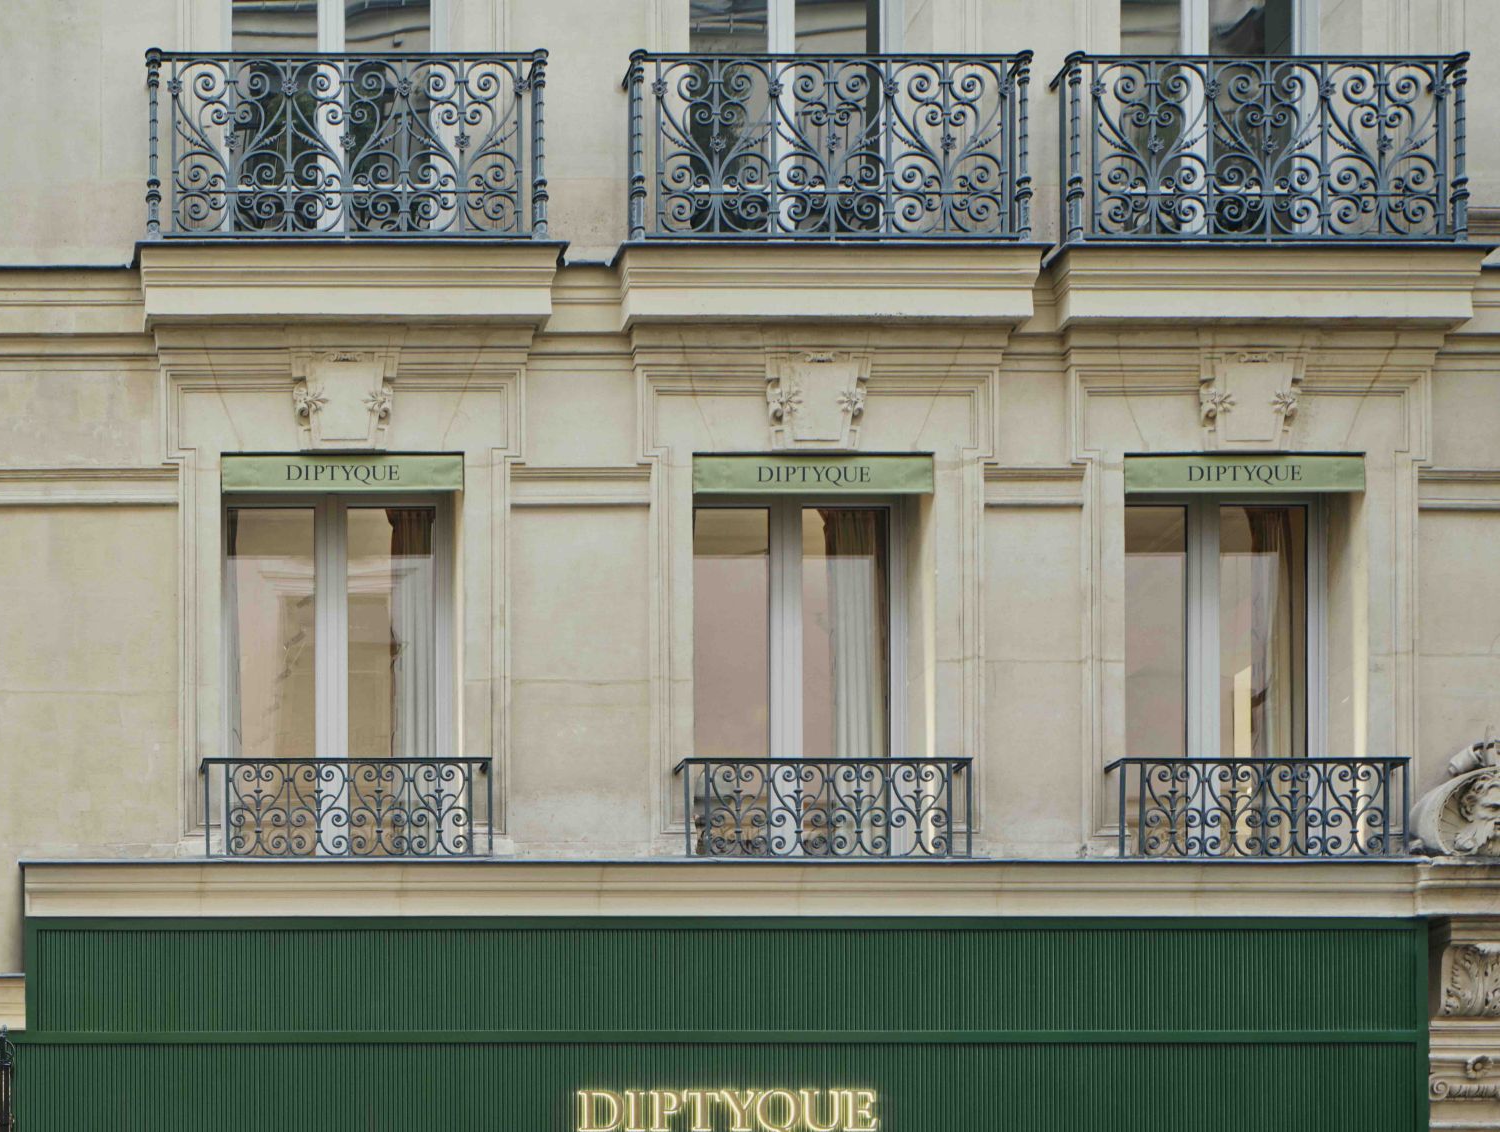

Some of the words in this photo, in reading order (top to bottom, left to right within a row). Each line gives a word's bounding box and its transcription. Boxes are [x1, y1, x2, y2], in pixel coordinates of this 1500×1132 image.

[285, 464, 400, 485] DIPTYQUE
[757, 465, 871, 486] DIPTYQUE
[1188, 464, 1302, 485] DIPTYQUE
